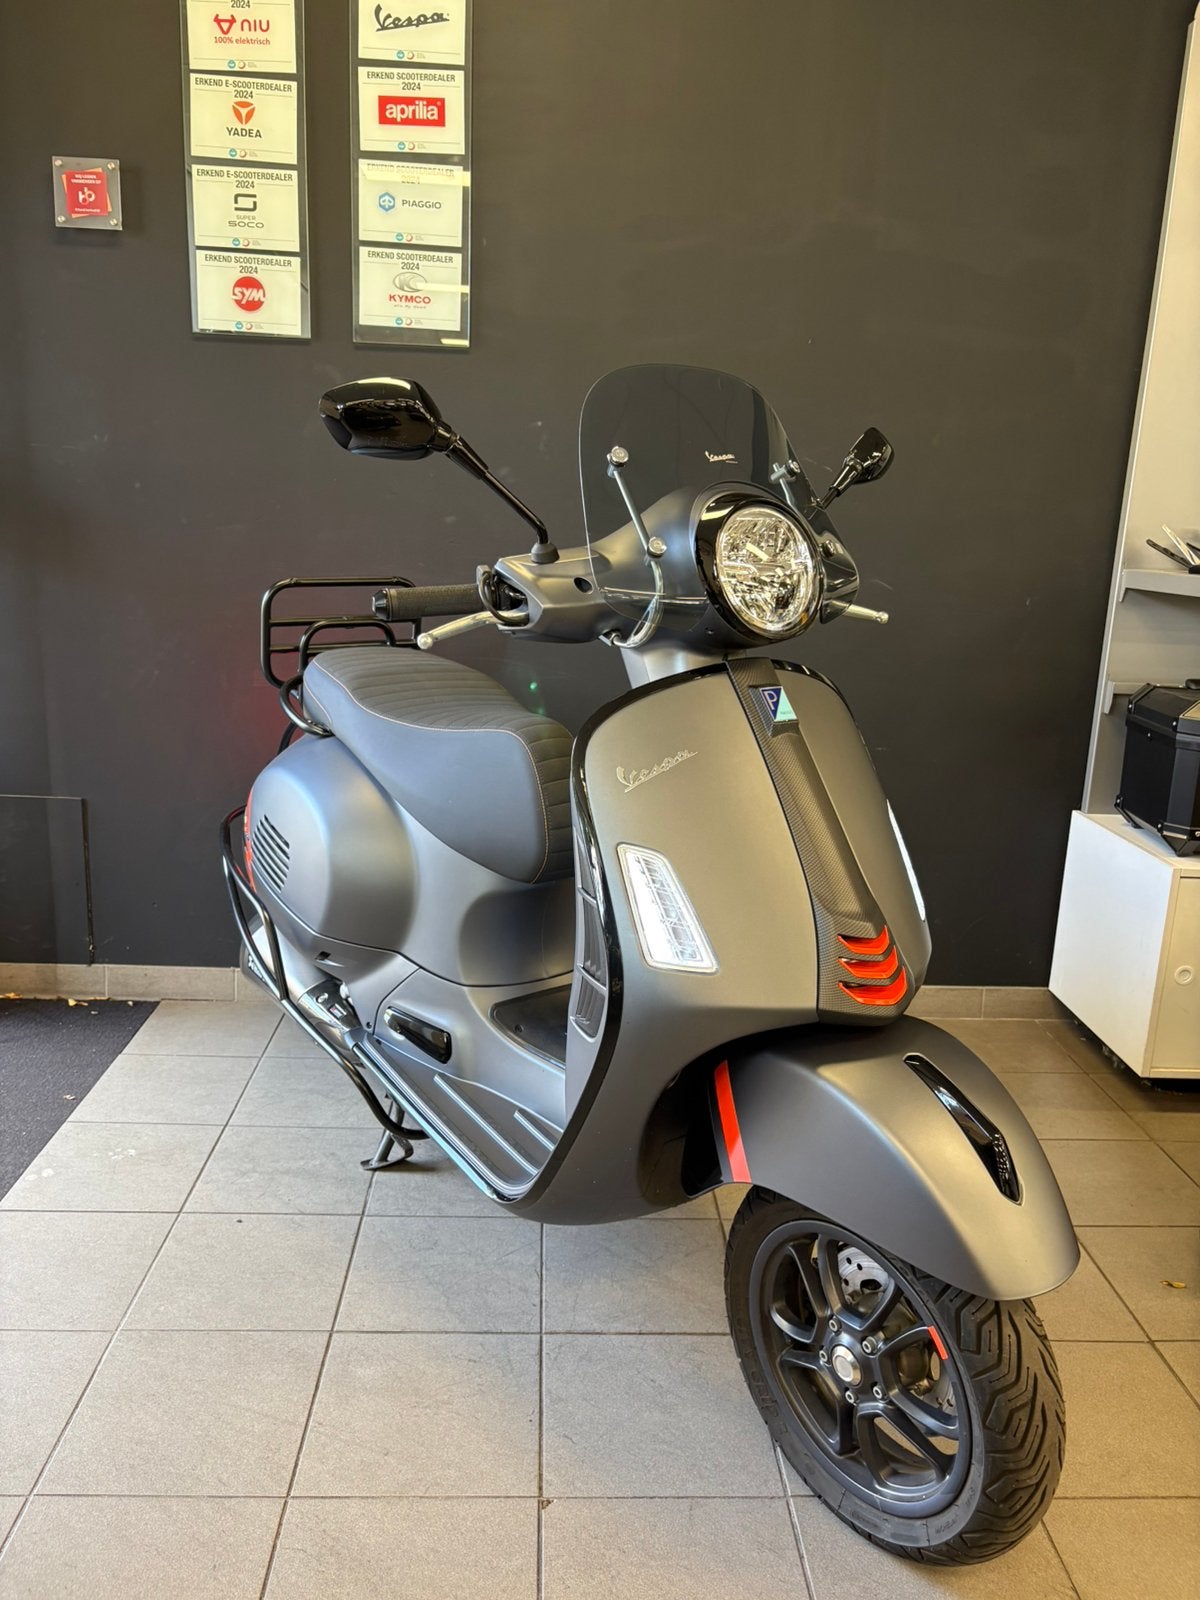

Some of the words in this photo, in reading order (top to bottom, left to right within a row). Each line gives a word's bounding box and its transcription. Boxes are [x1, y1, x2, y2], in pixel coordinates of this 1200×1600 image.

[231, 0, 251, 8] 2024
[374, 3, 450, 32] Vespa
[214, 36, 233, 44] 100%
[235, 37, 270, 45] elektrisch
[367, 71, 394, 80] ERKEND
[396, 73, 455, 82] SCOOTERDEALER
[195, 77, 223, 87] ERKEND
[225, 79, 292, 92] E-SCOOTERDEALER
[402, 82, 421, 91] 2024
[234, 90, 253, 99] 2024
[385, 100, 438, 122] aprilia
[226, 127, 262, 138] YADEA
[196, 168, 224, 177] ERKEND
[227, 170, 293, 181] E-SCOOTERDEALER
[235, 180, 255, 189] 2024
[402, 199, 442, 210] PIAGGIO
[228, 220, 265, 229] SOCO
[205, 254, 232, 263] ERKEND
[234, 256, 292, 267] SCOOTERDEALER
[367, 250, 394, 259] ERKEND
[396, 252, 454, 264] SCOOTERDEALER
[239, 266, 258, 274] 2024
[401, 262, 420, 270] 2024
[232, 287, 266, 304] SYM
[388, 294, 431, 304] KYMCO
[763, 690, 778, 710] P
[616, 749, 699, 793] Vespa
